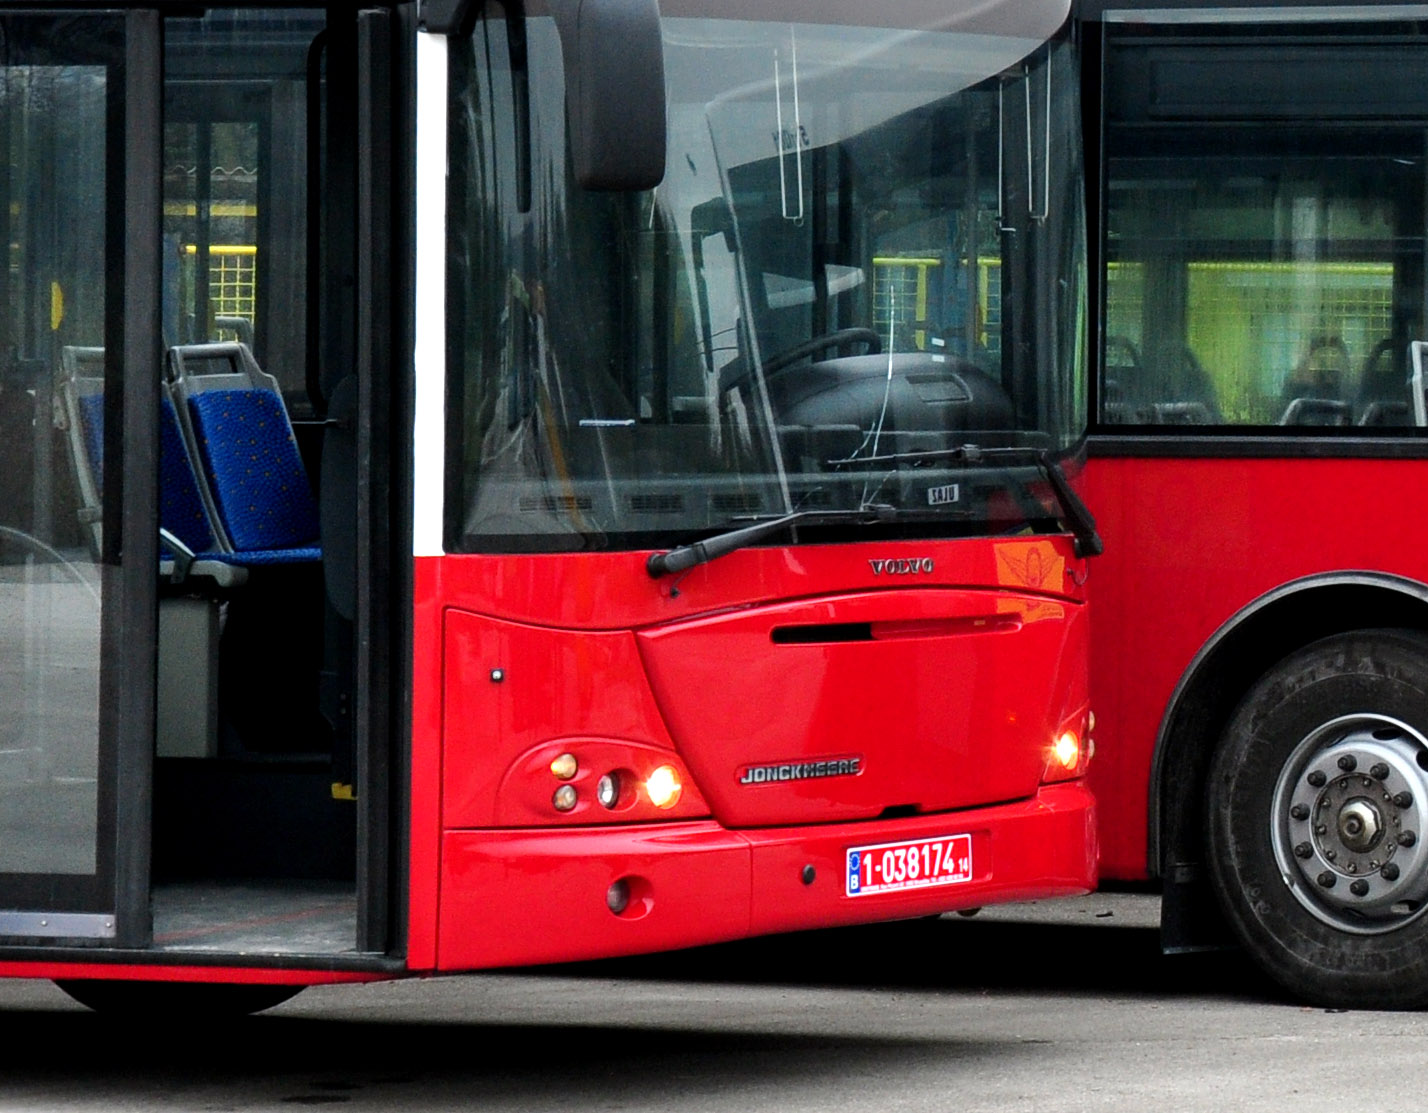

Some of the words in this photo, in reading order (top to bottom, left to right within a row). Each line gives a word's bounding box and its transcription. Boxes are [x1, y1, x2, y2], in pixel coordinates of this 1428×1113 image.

[868, 557, 935, 576] VOLVO
[740, 757, 860, 785] JONCKHEERE
[862, 841, 955, 886] 1-038174
[957, 857, 969, 873] 14
[850, 874, 859, 890] B
